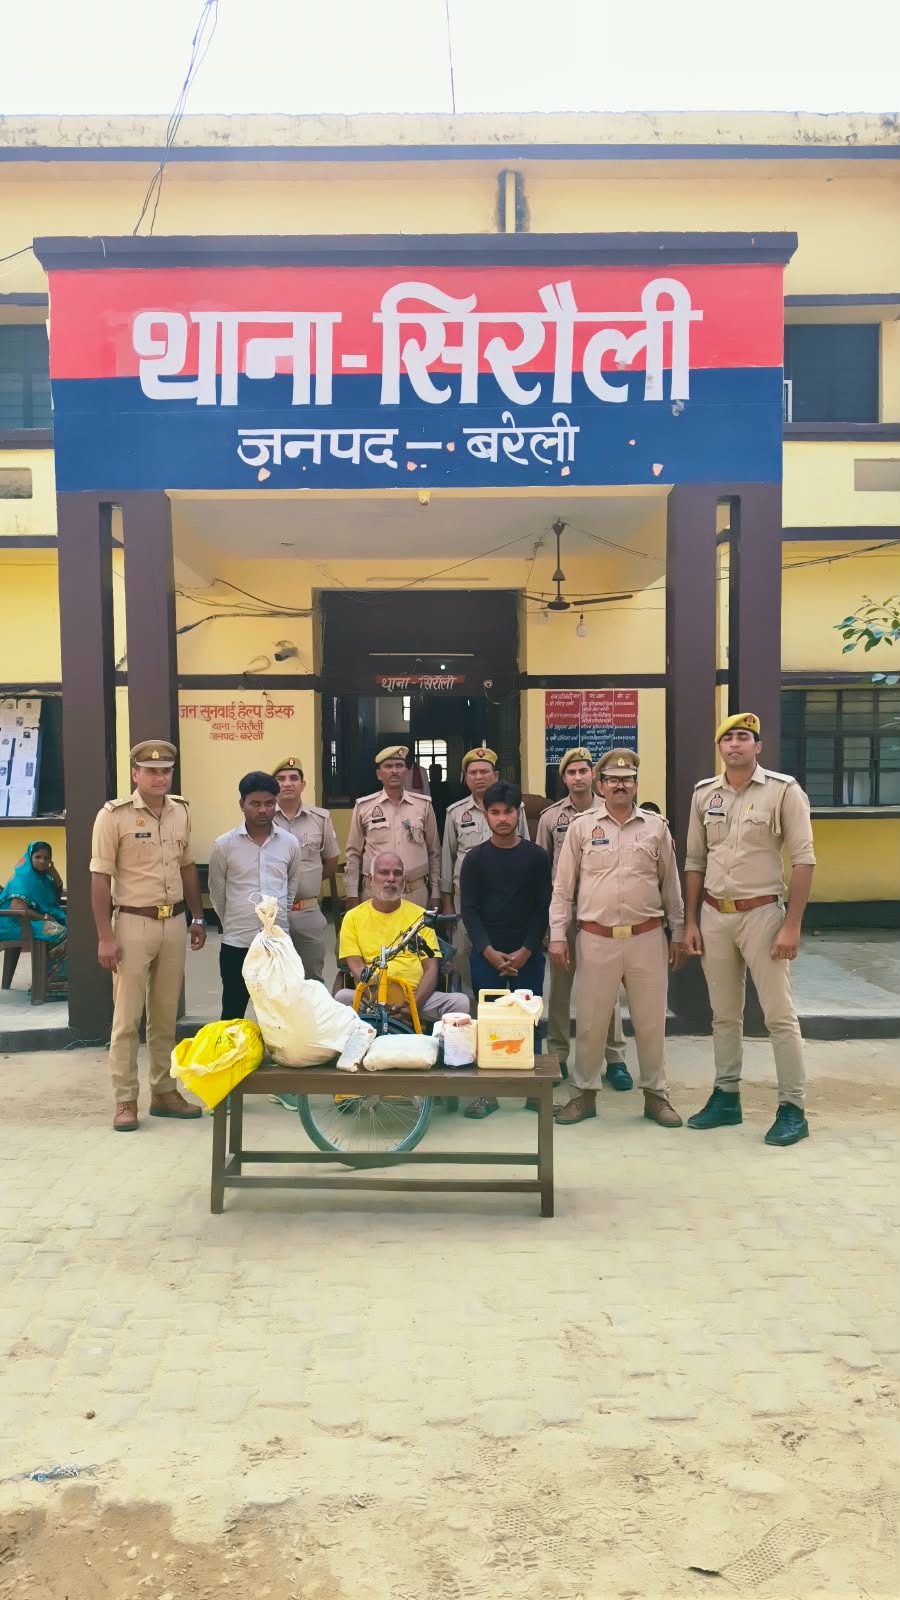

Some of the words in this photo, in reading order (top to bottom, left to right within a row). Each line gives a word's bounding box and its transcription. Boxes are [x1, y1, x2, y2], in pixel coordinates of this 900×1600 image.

[237, 428, 399, 469] जनपद
[462, 410, 580, 465] बरेली
[178, 704, 198, 719] जन
[200, 701, 237, 722] सुनवाई
[237, 701, 263, 719] हेल्प
[264, 700, 294, 719] डेस्क
